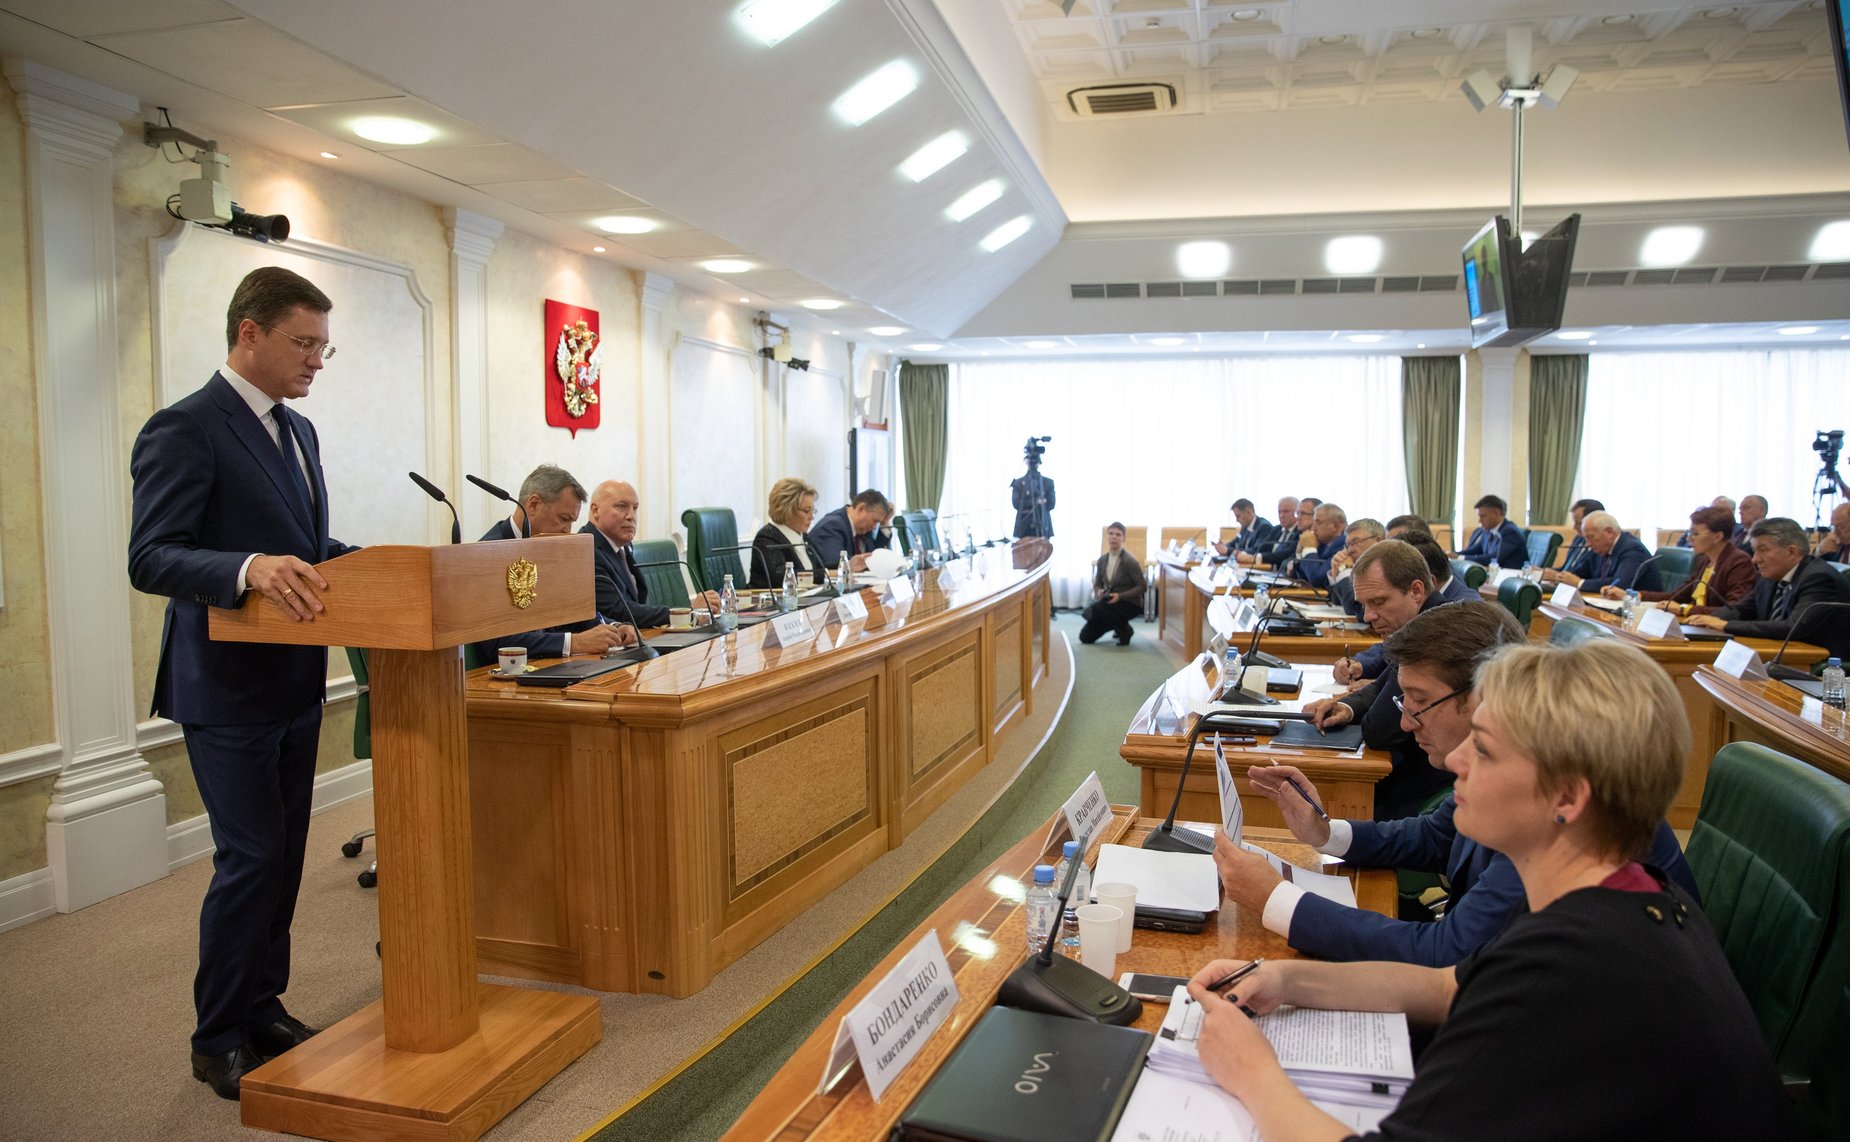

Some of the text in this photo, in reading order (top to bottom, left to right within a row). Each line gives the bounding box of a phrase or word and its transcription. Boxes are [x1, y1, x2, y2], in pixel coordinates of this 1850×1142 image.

[867, 961, 938, 1046] БОНДАРЕНКО
[875, 986, 949, 1071] Анастасия Борисовна
[1014, 1052, 1053, 1094] VAIO
